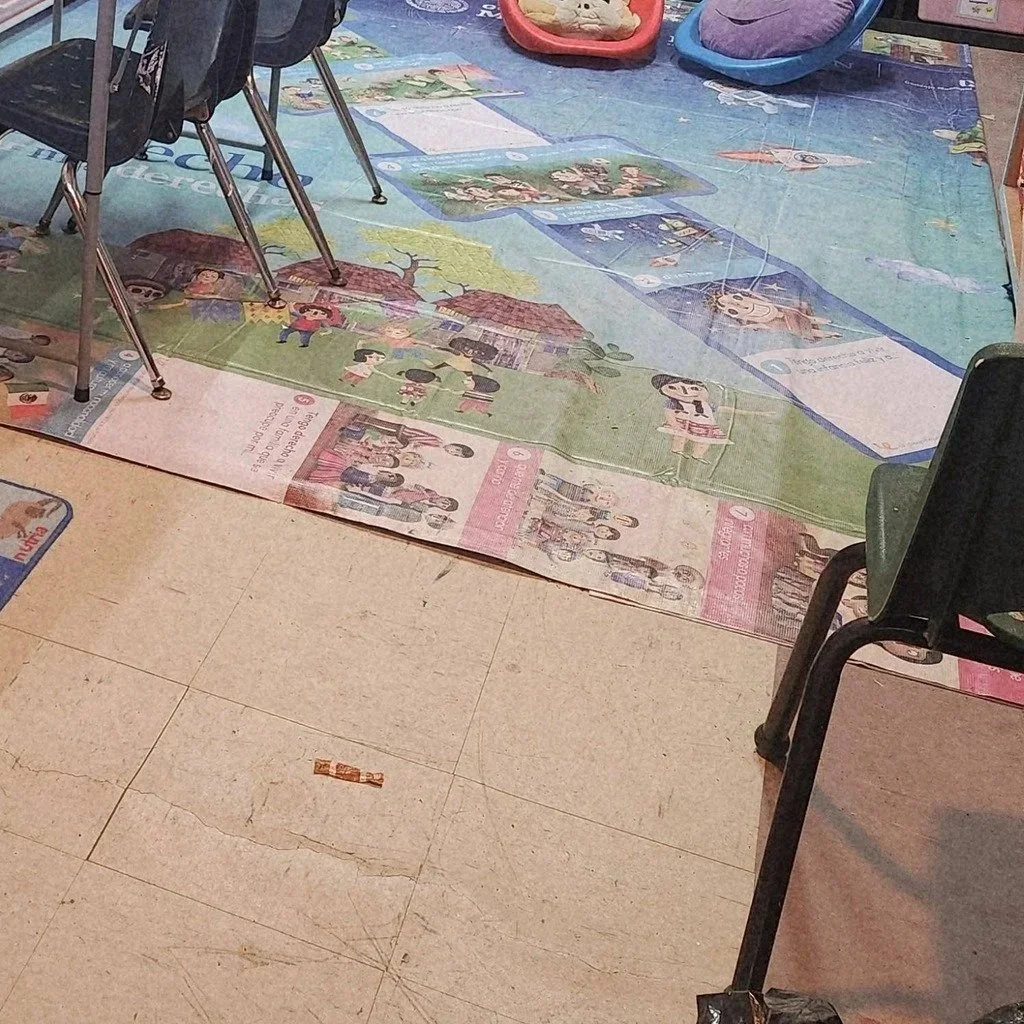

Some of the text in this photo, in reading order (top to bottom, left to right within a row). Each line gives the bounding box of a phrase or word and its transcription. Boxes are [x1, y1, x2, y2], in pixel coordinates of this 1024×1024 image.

[252, 401, 285, 445] preocupe por
[297, 411, 319, 431] Tengo
[255, 450, 271, 465] que
[280, 430, 306, 458] derecho
[13, 524, 49, 563] nutria
